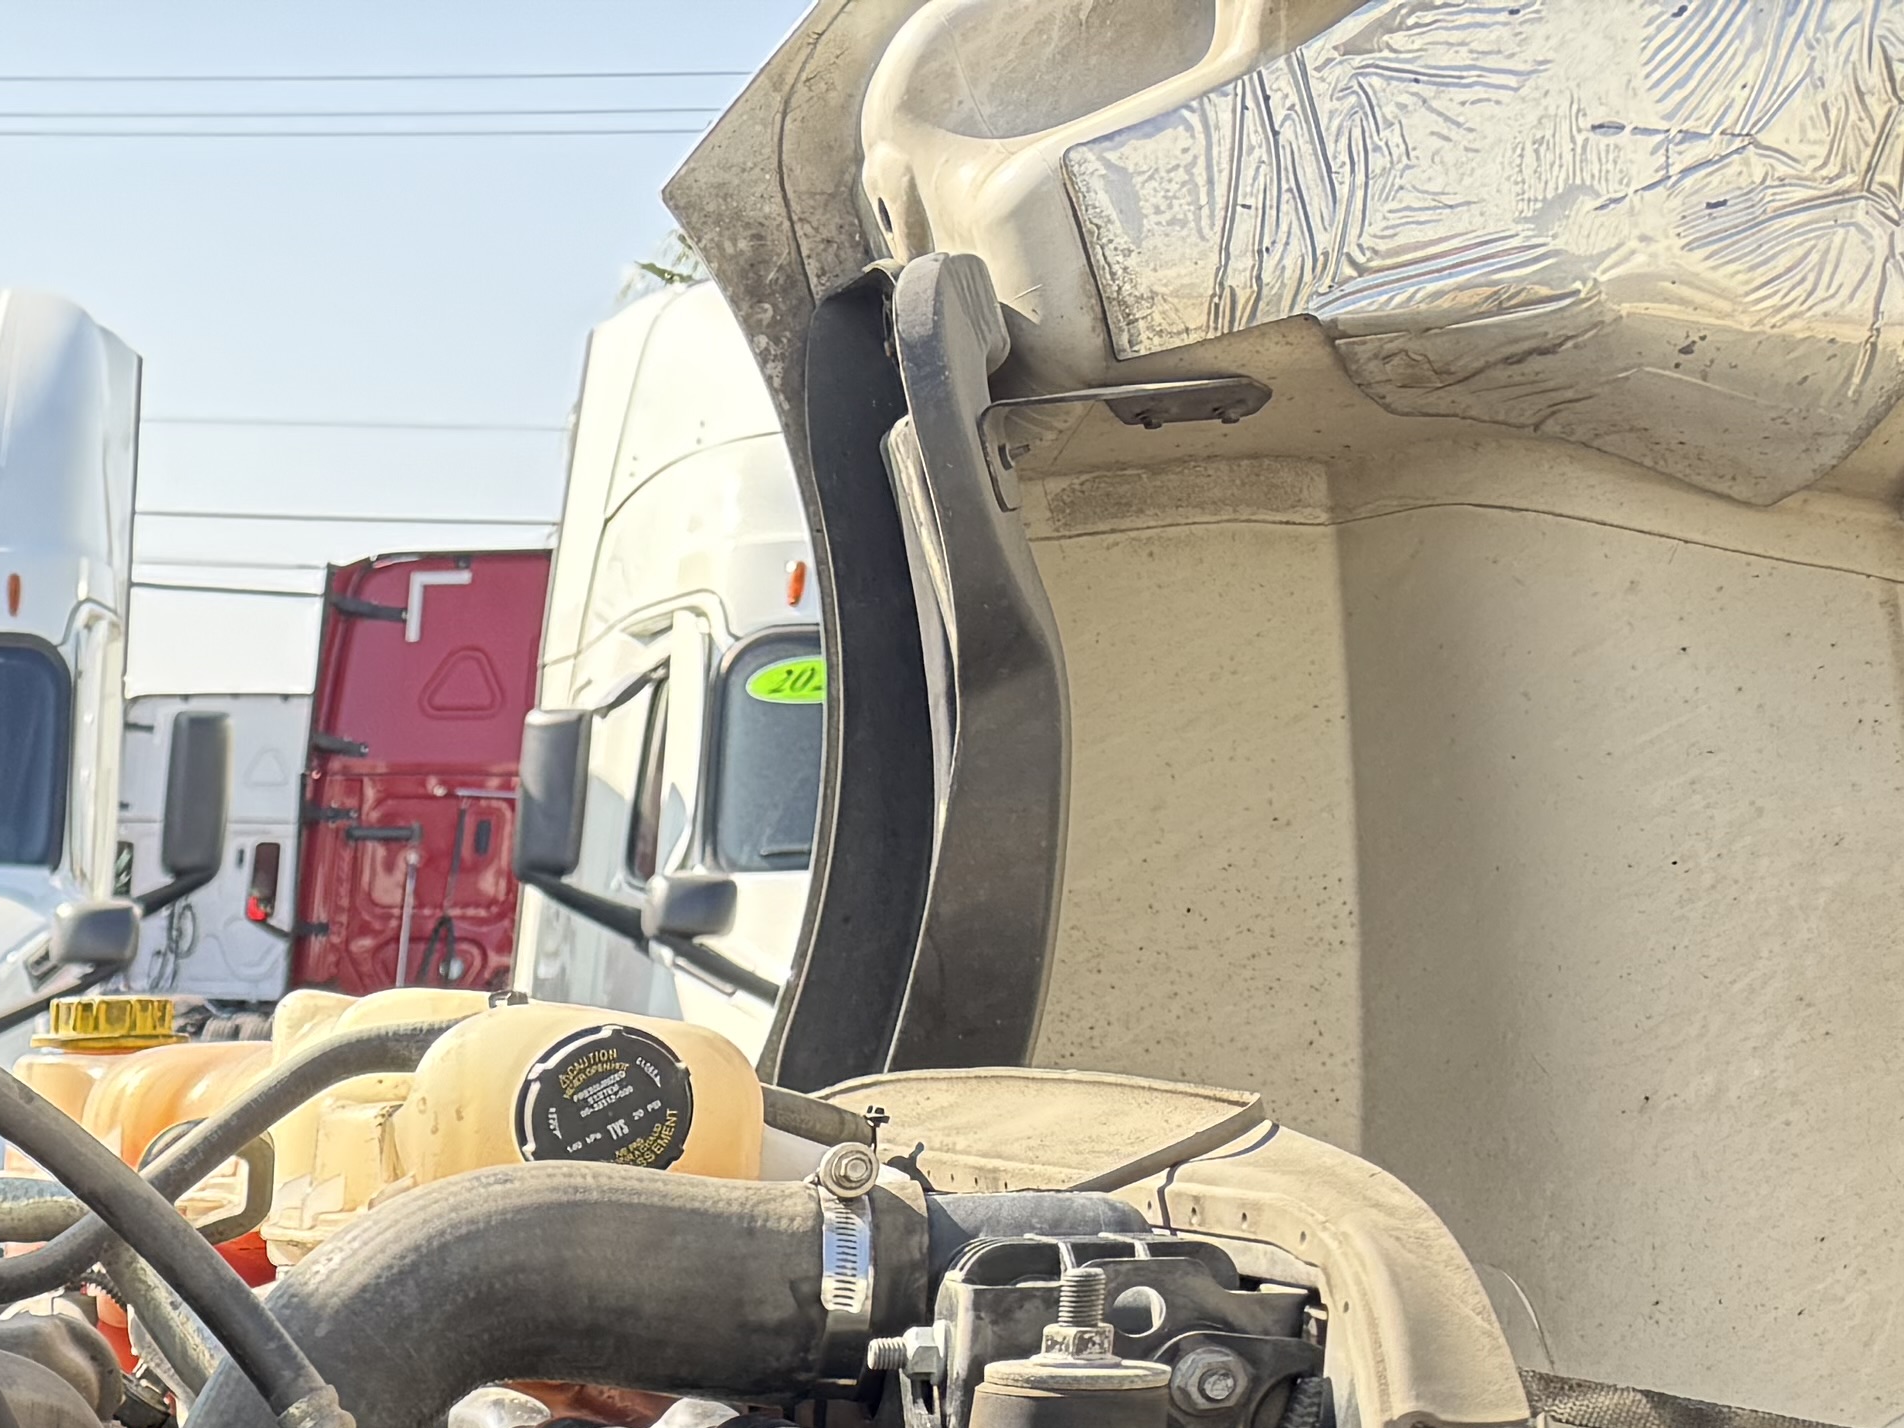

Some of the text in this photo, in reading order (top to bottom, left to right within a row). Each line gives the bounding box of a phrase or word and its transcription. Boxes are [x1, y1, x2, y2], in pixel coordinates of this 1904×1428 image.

[768, 666, 823, 695] 20
[567, 1048, 618, 1079] CAUTION
[606, 1118, 631, 1141] TVS
